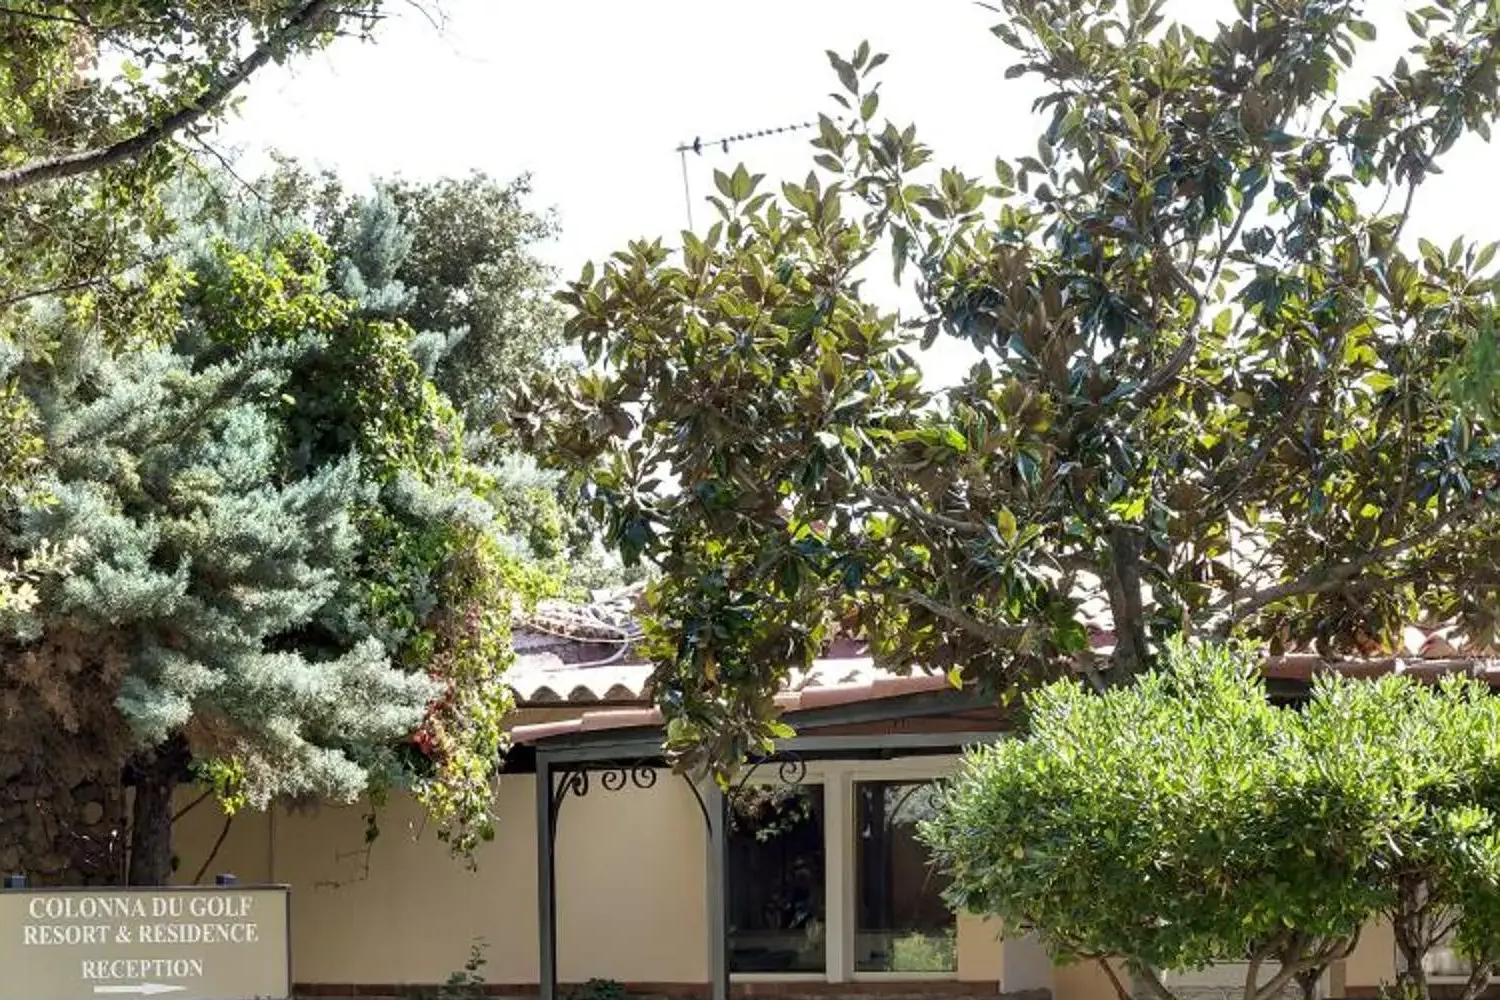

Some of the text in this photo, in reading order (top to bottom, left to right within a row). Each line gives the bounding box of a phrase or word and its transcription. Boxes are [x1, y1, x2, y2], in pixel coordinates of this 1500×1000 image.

[28, 895, 253, 919] COLONNA DU GOLF
[23, 923, 259, 945] RESORT & RESIDENCE
[82, 959, 204, 979] RECEPTION
